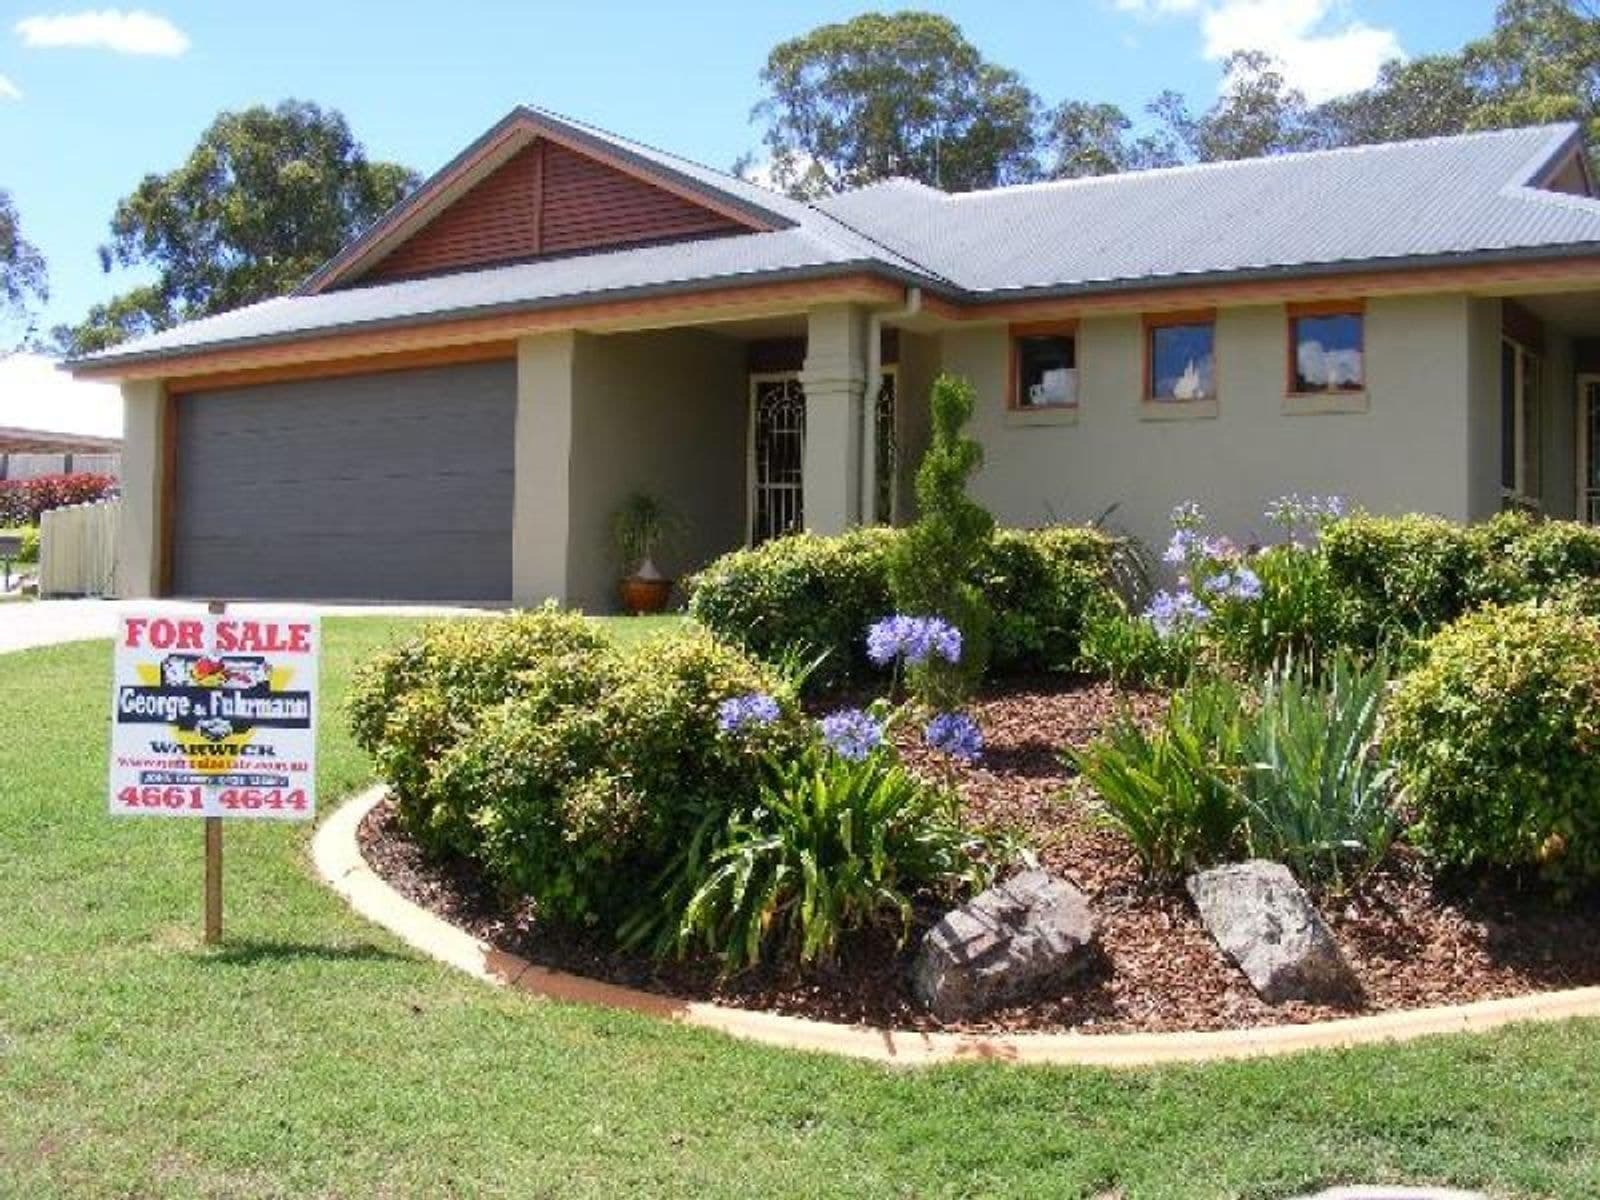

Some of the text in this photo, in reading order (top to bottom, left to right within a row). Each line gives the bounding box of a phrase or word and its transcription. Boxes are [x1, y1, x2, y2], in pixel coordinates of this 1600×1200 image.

[125, 618, 311, 652] FOR SALE
[120, 689, 190, 719] George
[211, 690, 308, 719] Fuhrmann
[150, 741, 276, 756] WARWICK
[118, 786, 308, 810] 4661 4644
